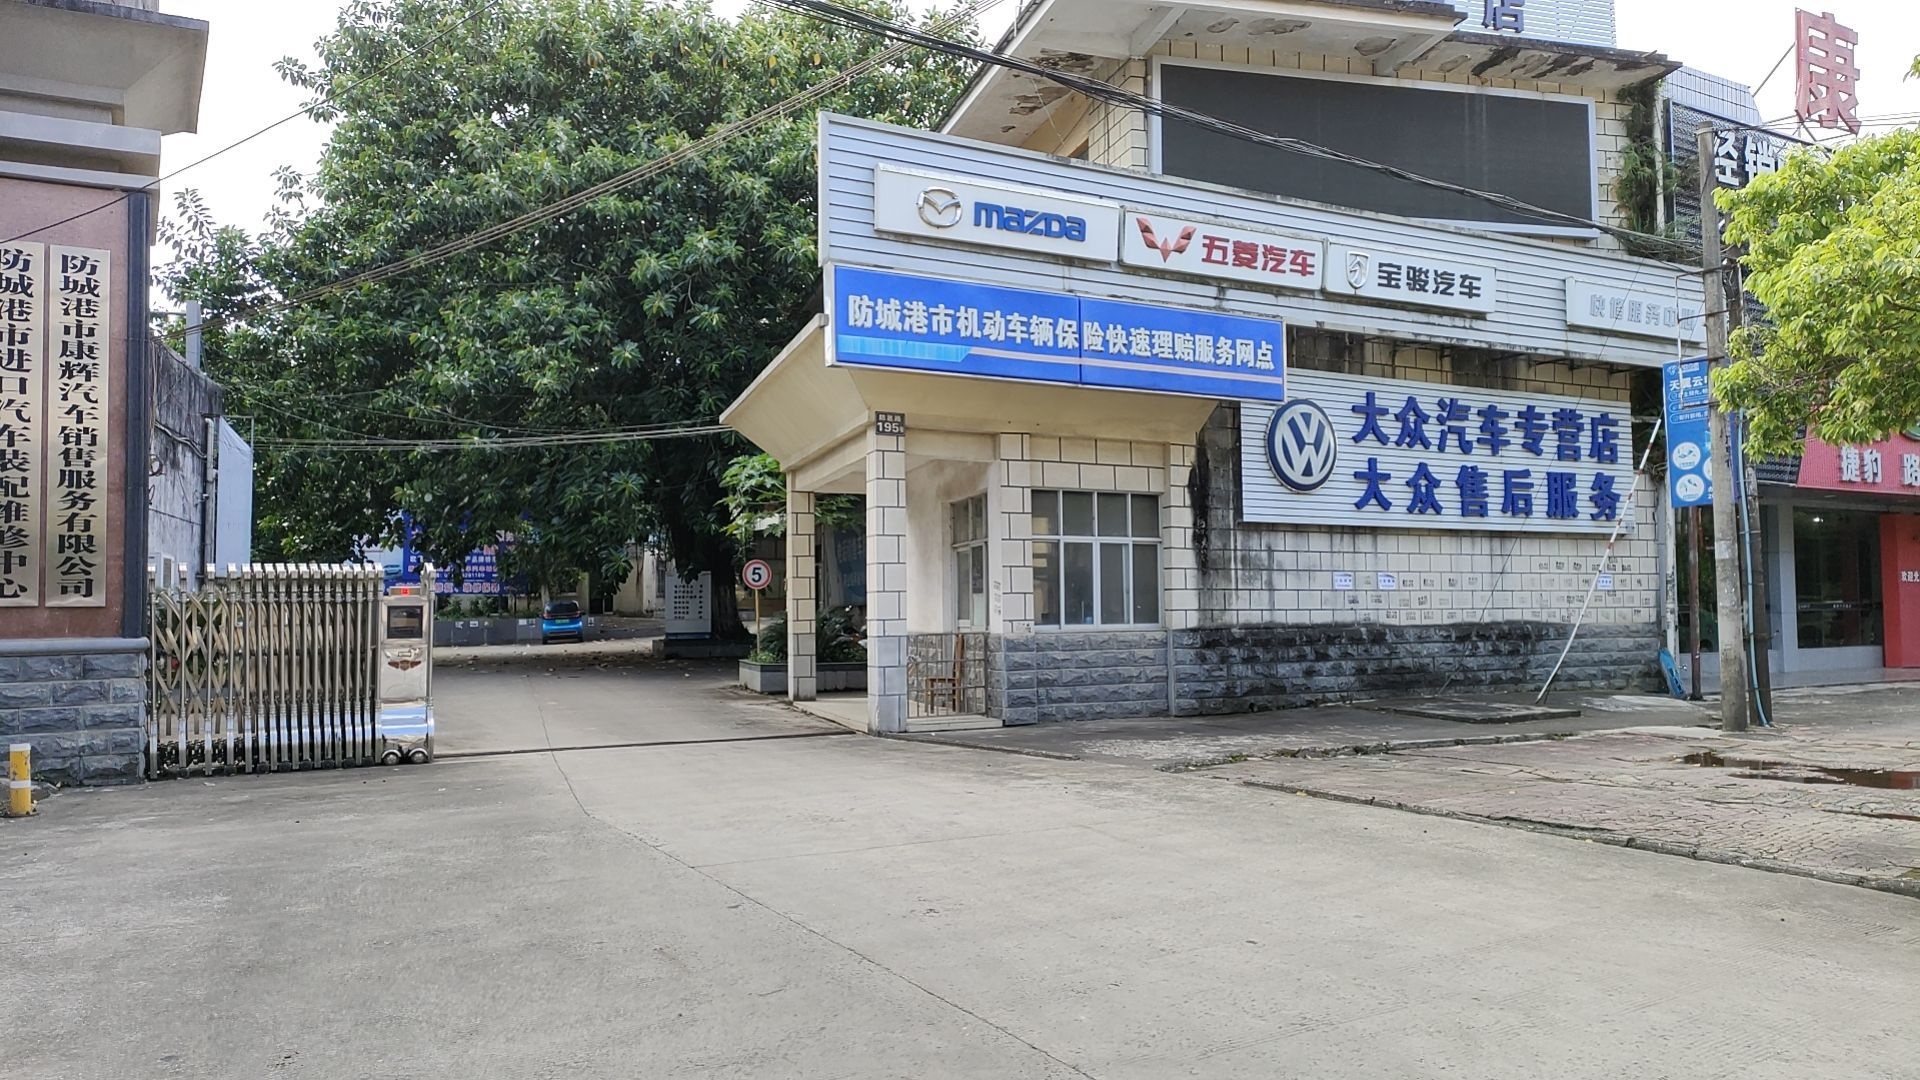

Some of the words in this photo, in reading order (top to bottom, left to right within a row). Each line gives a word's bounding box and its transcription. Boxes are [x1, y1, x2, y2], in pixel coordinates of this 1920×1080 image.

[1795, 7, 1863, 135] 康
[1201, 234, 1316, 277] 五菱汽车
[1377, 262, 1482, 299] 宝骏汽车
[847, 294, 1275, 371] 防城港市机动车辆保险快速理赔服务网点
[1589, 293, 1696, 331] 快修服务中心
[0, 248, 34, 599] 防城港市进口汽车装配维修中心
[56, 253, 101, 599] 防城港市康辉汽车销售服务有限公司
[1351, 391, 1620, 464] 大众汽车专营店
[1353, 457, 1622, 521] 大众售后服务
[1840, 446, 1882, 484] 捷豹
[751, 566, 762, 583] 5
